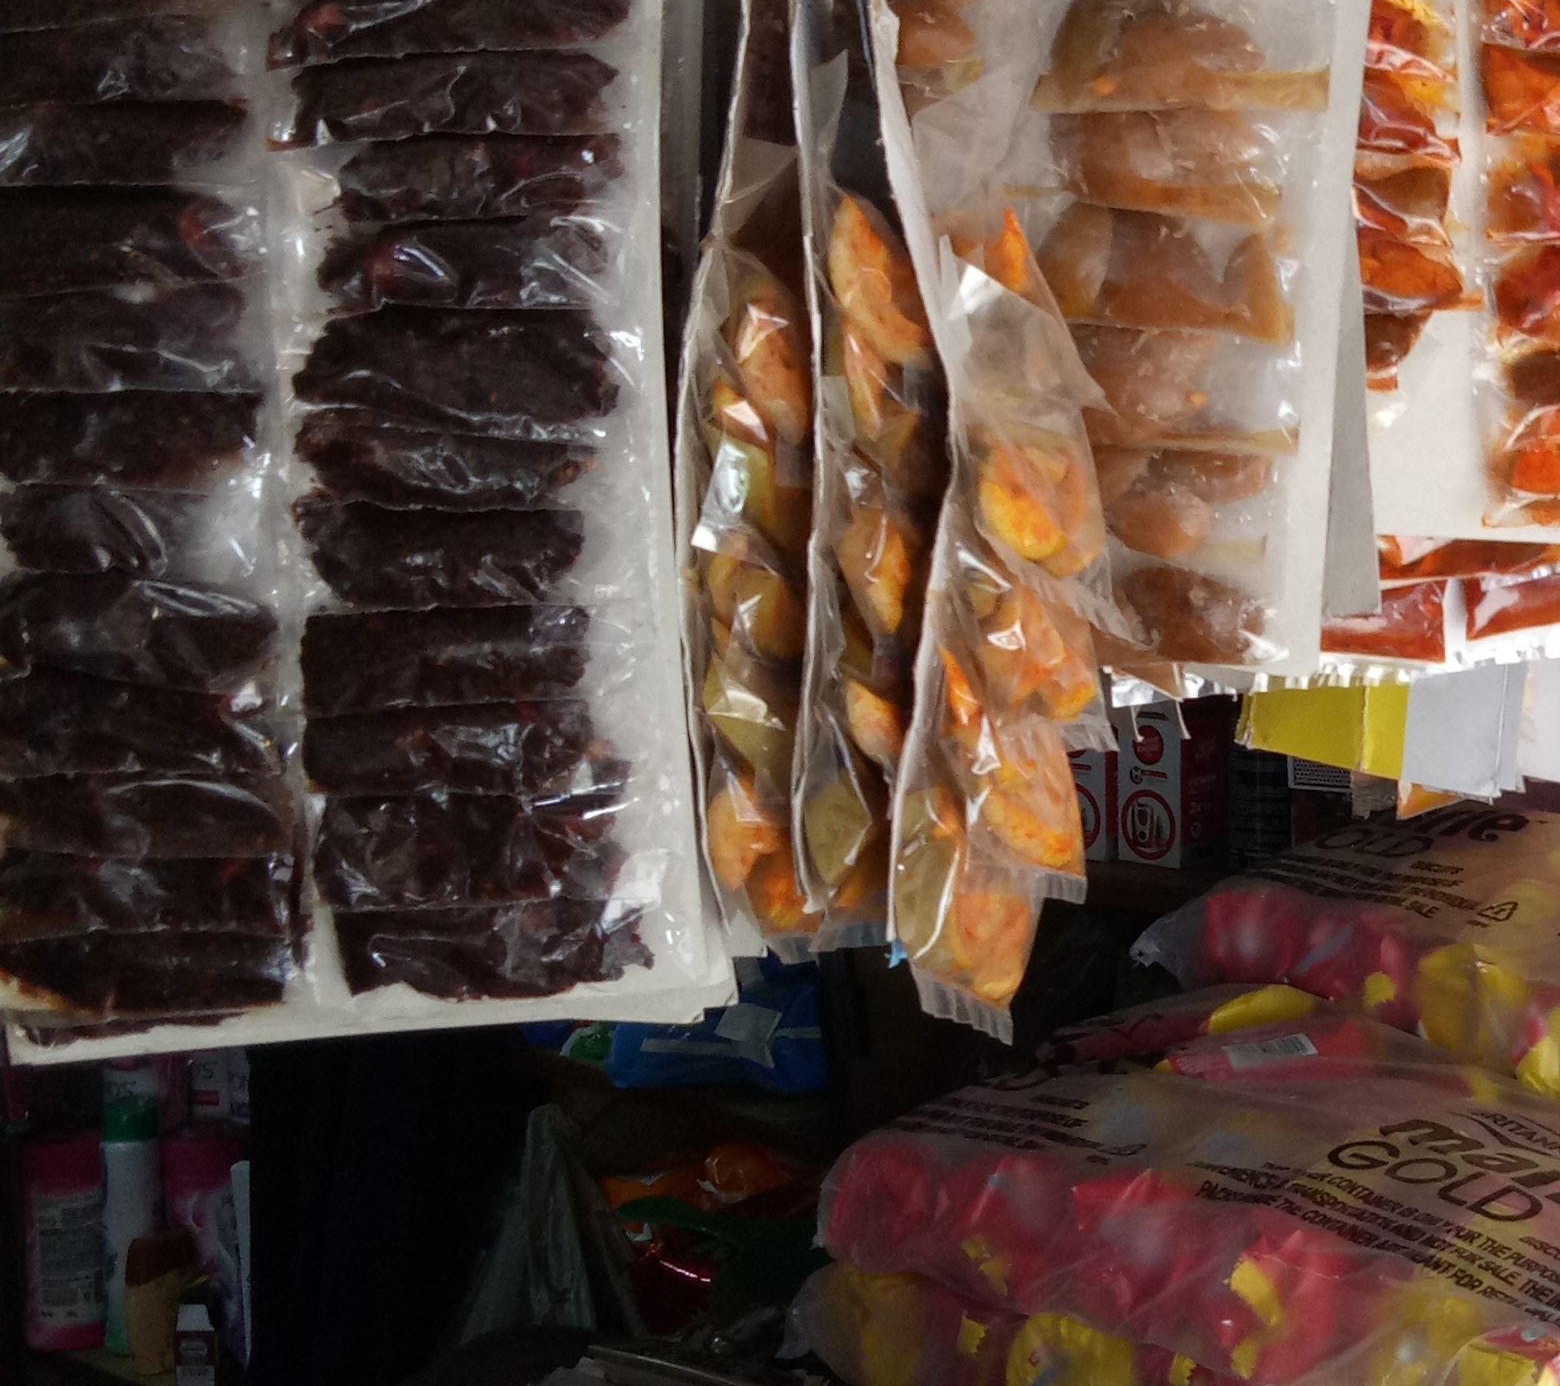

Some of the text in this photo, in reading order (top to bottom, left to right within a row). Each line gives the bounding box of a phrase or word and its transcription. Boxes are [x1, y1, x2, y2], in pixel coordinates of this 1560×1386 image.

[1328, 1140, 1543, 1222] GOLD
[1477, 1233, 1509, 1260] THE
[1451, 1267, 1482, 1291] FOR
[1519, 1277, 1553, 1304] THE
